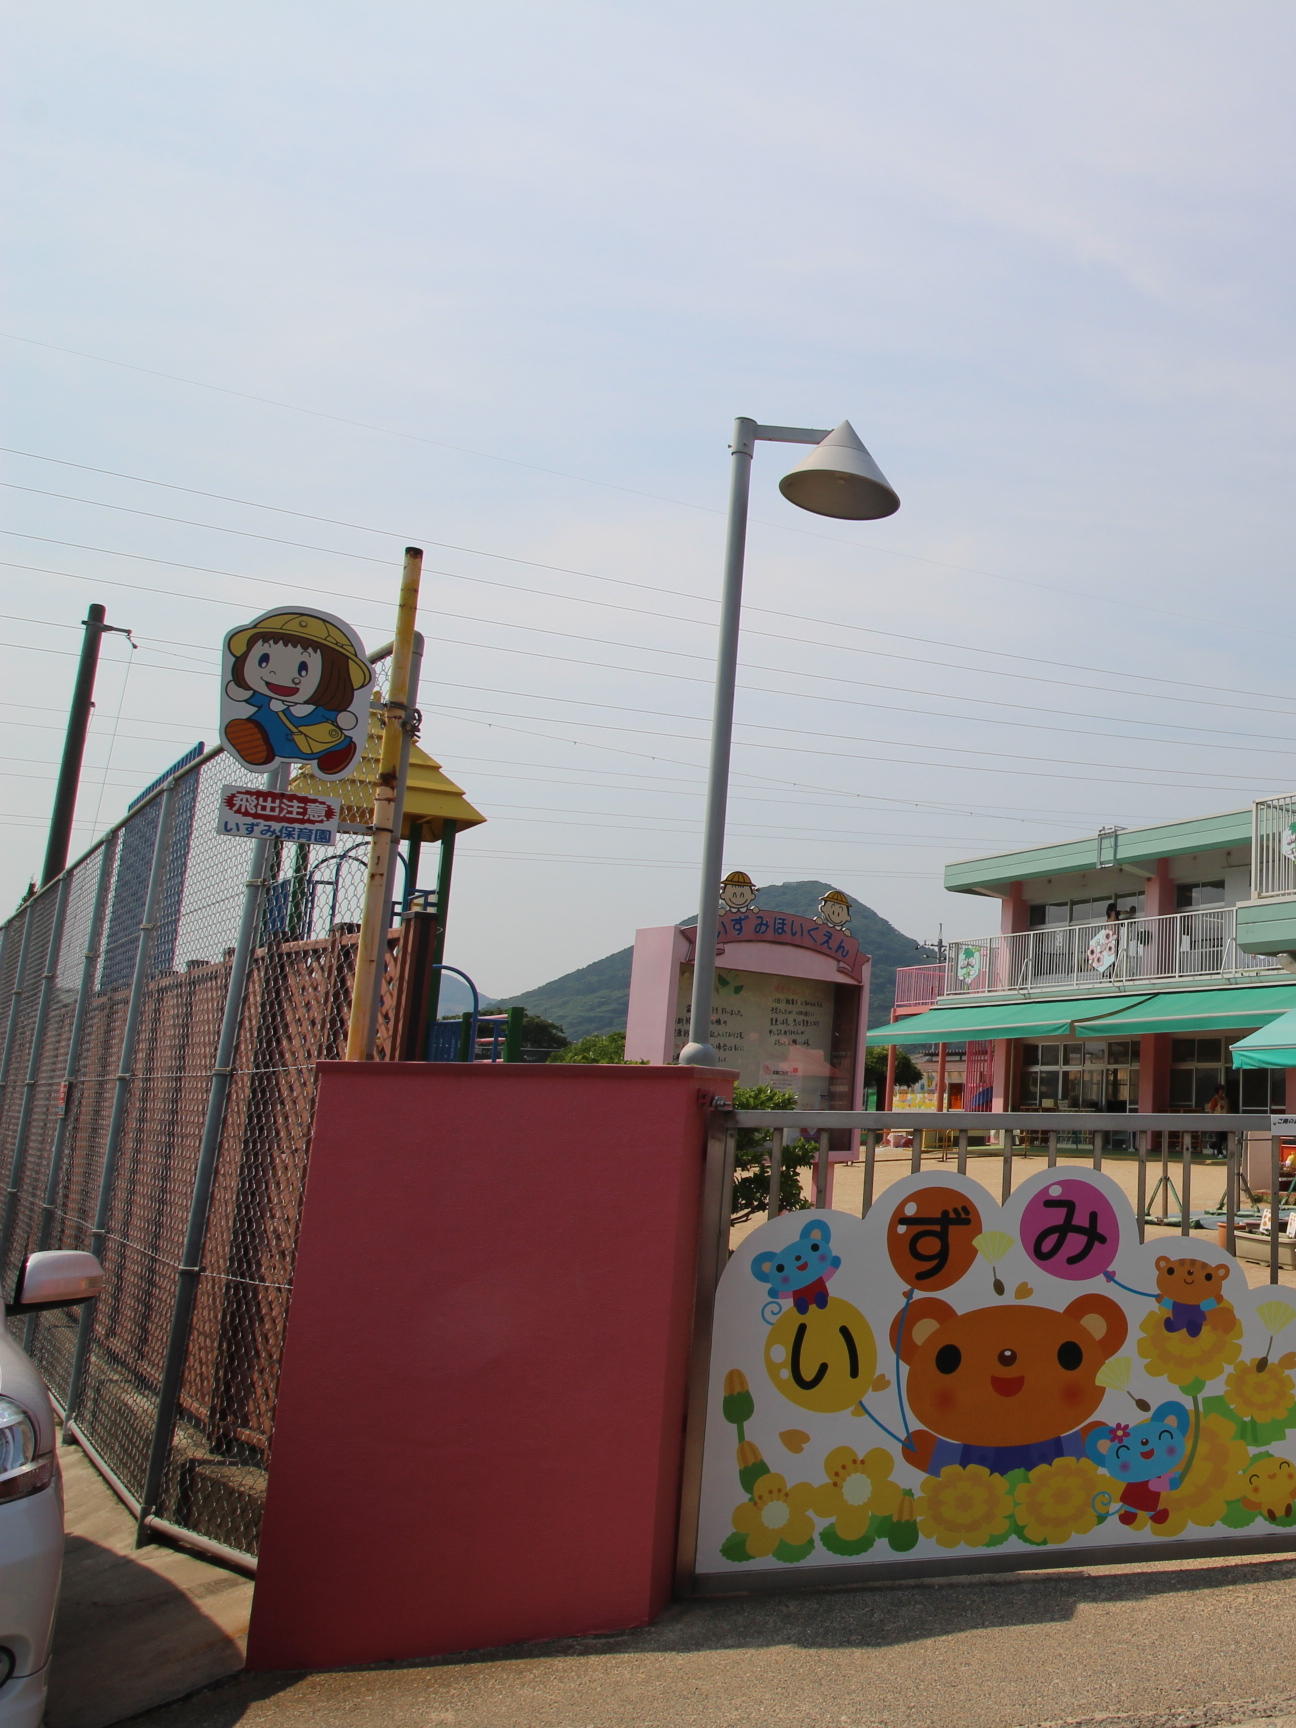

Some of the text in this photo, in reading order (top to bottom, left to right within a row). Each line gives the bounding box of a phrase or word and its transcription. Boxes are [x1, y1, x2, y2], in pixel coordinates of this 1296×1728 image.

[232, 794, 329, 821] 飛出注意
[223, 820, 332, 844] いずみ保育園
